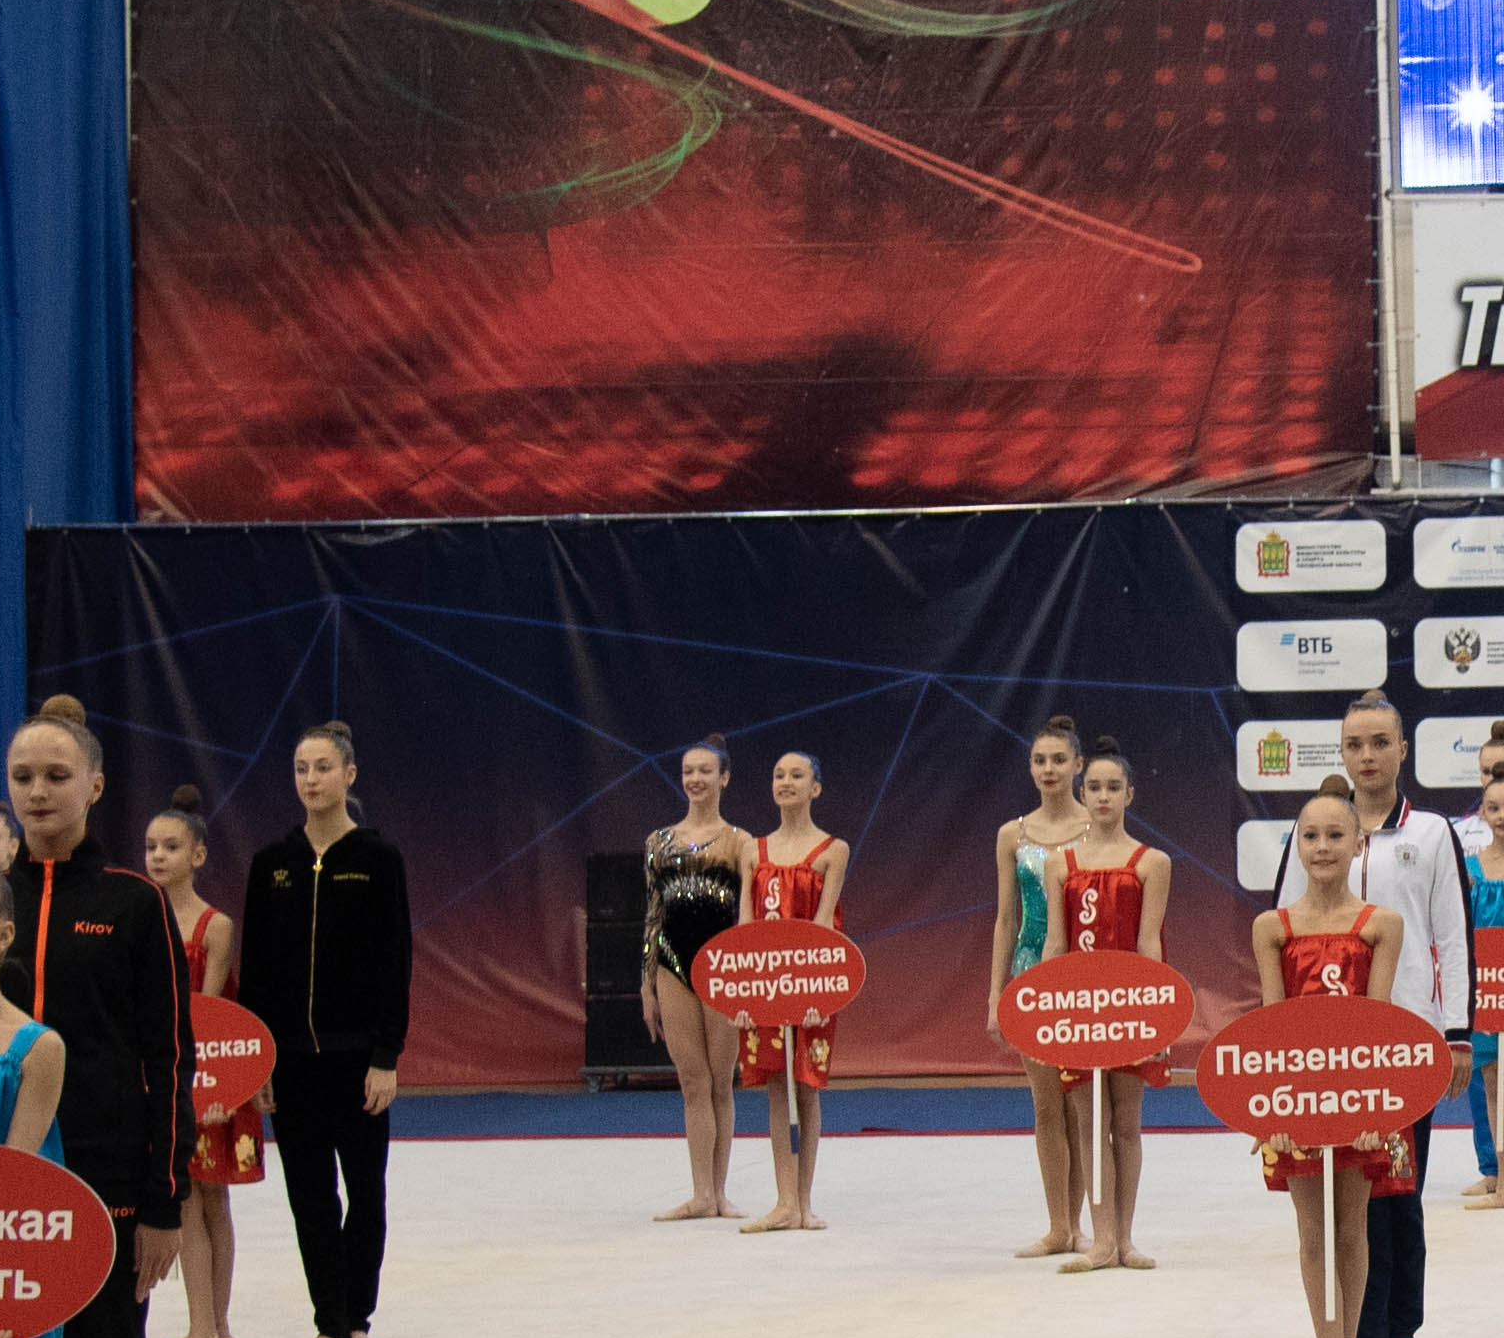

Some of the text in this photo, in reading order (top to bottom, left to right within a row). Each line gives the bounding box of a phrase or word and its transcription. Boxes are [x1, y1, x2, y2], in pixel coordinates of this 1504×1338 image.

[1298, 637, 1333, 654] ВТБ
[74, 921, 114, 935] Kirov
[707, 947, 847, 973] Удмуртская
[709, 973, 849, 1001] Республика
[1016, 984, 1176, 1017] Самарская
[1036, 1019, 1157, 1045] область
[1216, 1042, 1434, 1076] Пензенская
[1248, 1085, 1404, 1117] область
[109, 1206, 136, 1219] irov
